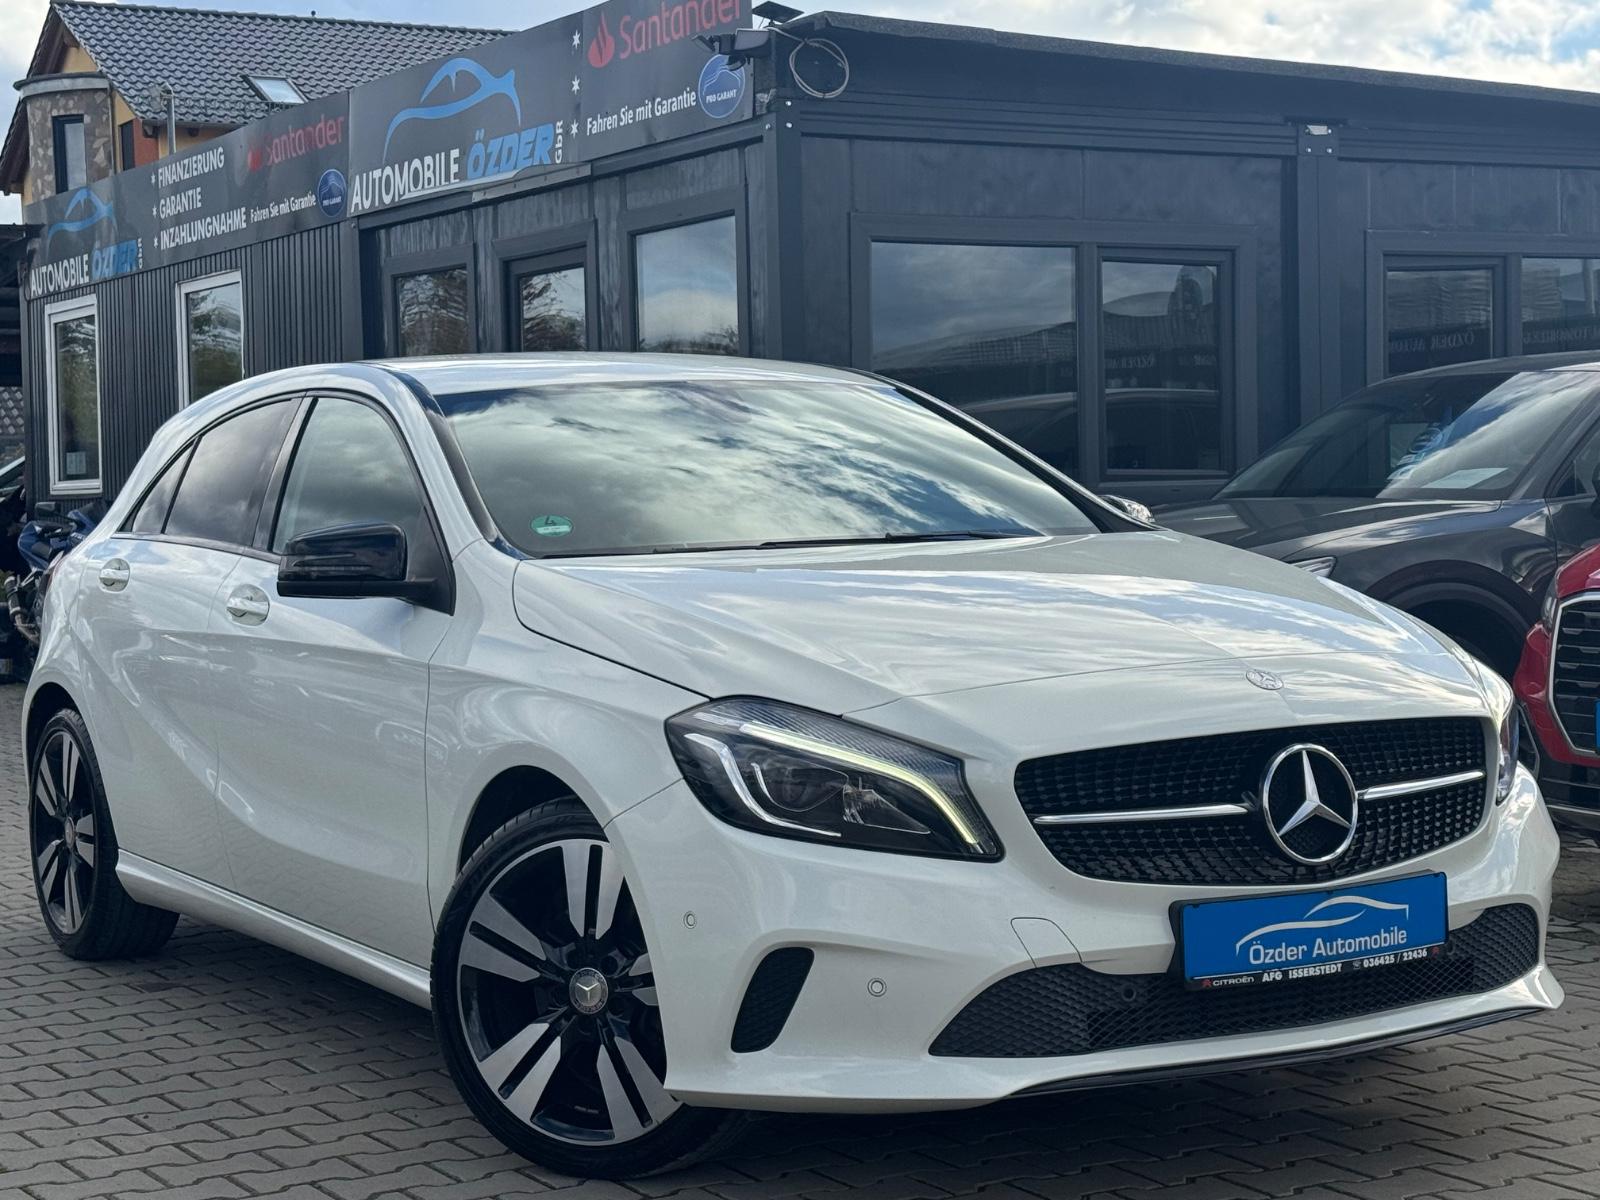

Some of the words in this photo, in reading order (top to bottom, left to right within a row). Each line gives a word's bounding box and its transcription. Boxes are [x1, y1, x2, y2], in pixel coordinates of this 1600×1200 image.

[586, 114, 618, 136] Fahren
[619, 106, 634, 126] Sie
[635, 100, 652, 121] mit
[654, 87, 697, 117] Garantie
[717, 89, 738, 101] GARANT
[555, 119, 564, 164] GbR
[158, 146, 225, 189] FINANZIERUNG
[350, 148, 460, 213] AUTOMOBILE
[467, 123, 555, 180] ÖZDER
[160, 187, 202, 219] GARANTIE
[250, 205, 270, 223] Fahren
[270, 202, 279, 217] Sie
[280, 198, 290, 214] mit
[290, 191, 316, 211] Garantie
[160, 207, 247, 250] INZAHLUNGNAHME
[31, 253, 89, 297] AUTOMOBILE
[1249, 941, 1308, 965] Özder
[1312, 926, 1407, 958] Automobile
[1262, 971, 1283, 982] AFG
[1289, 963, 1343, 979] ISSERSTEDT
[1363, 954, 1395, 968] 036425
[1402, 948, 1428, 961] 22436
